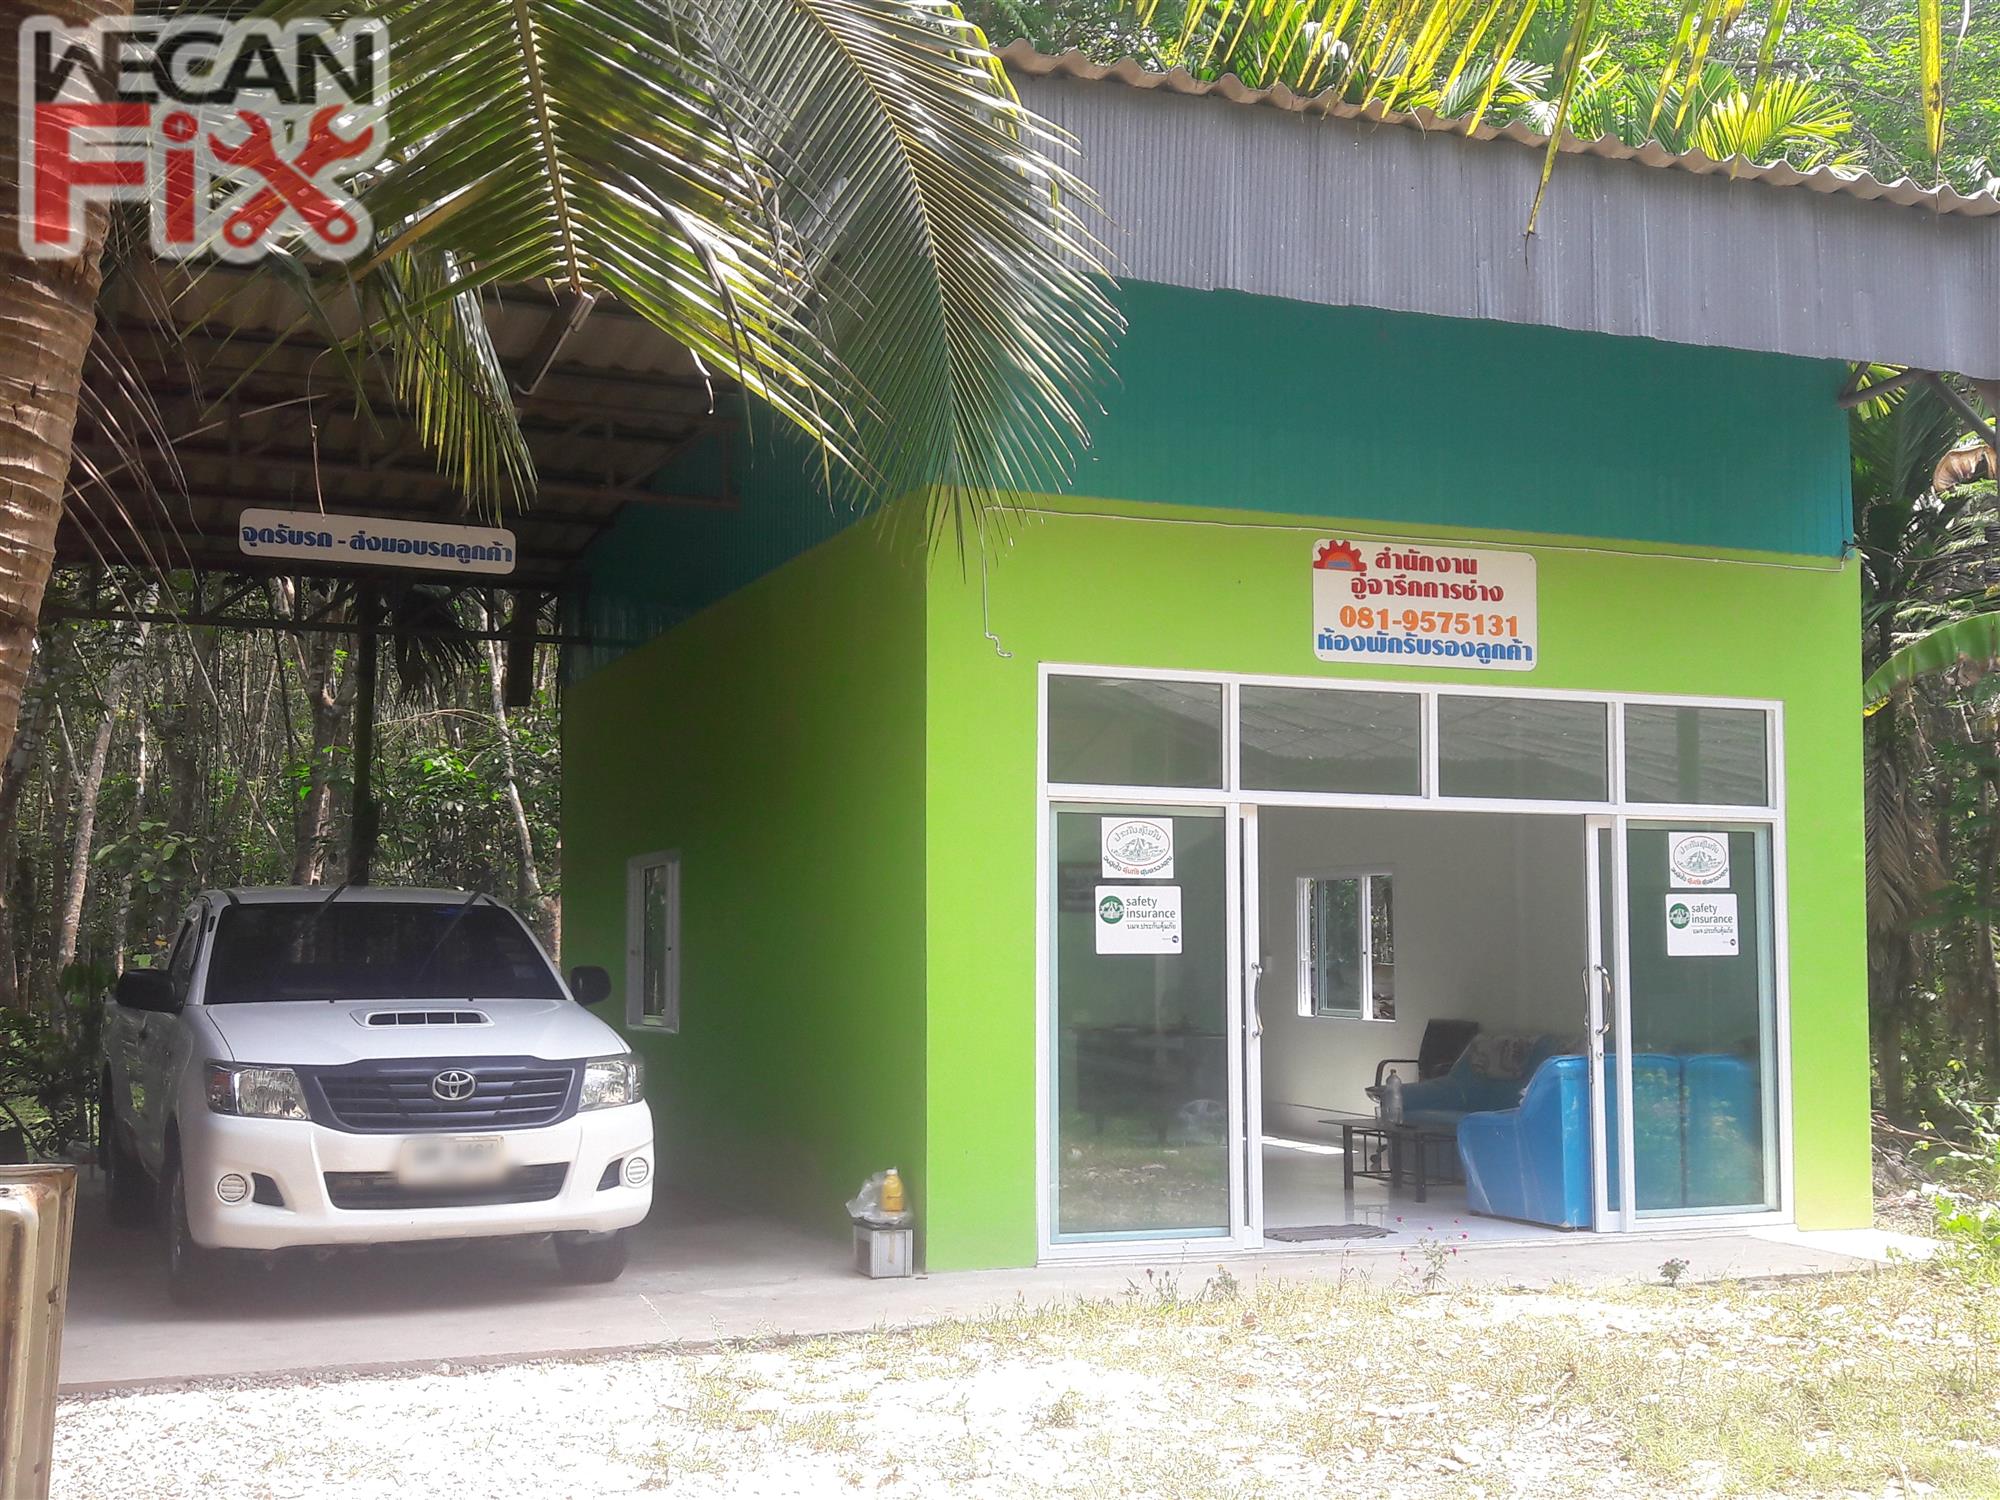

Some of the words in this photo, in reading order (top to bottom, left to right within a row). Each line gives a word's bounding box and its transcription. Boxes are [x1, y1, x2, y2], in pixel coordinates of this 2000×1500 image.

[241, 523, 333, 548] จุดรับรถ
[349, 530, 513, 564] ส่งมอบรถลูกค้า
[1375, 546, 1478, 575] สำนักงาน
[1350, 572, 1505, 602] อู่จารึกการช่าง
[1338, 604, 1519, 638] 081-9575131
[1317, 627, 1533, 665] ห้องพักรับรองลูกค้า
[1126, 895, 1158, 909] safety
[1126, 907, 1176, 919] insurance
[1691, 902, 1718, 915] safety
[1691, 913, 1733, 924] insurance
